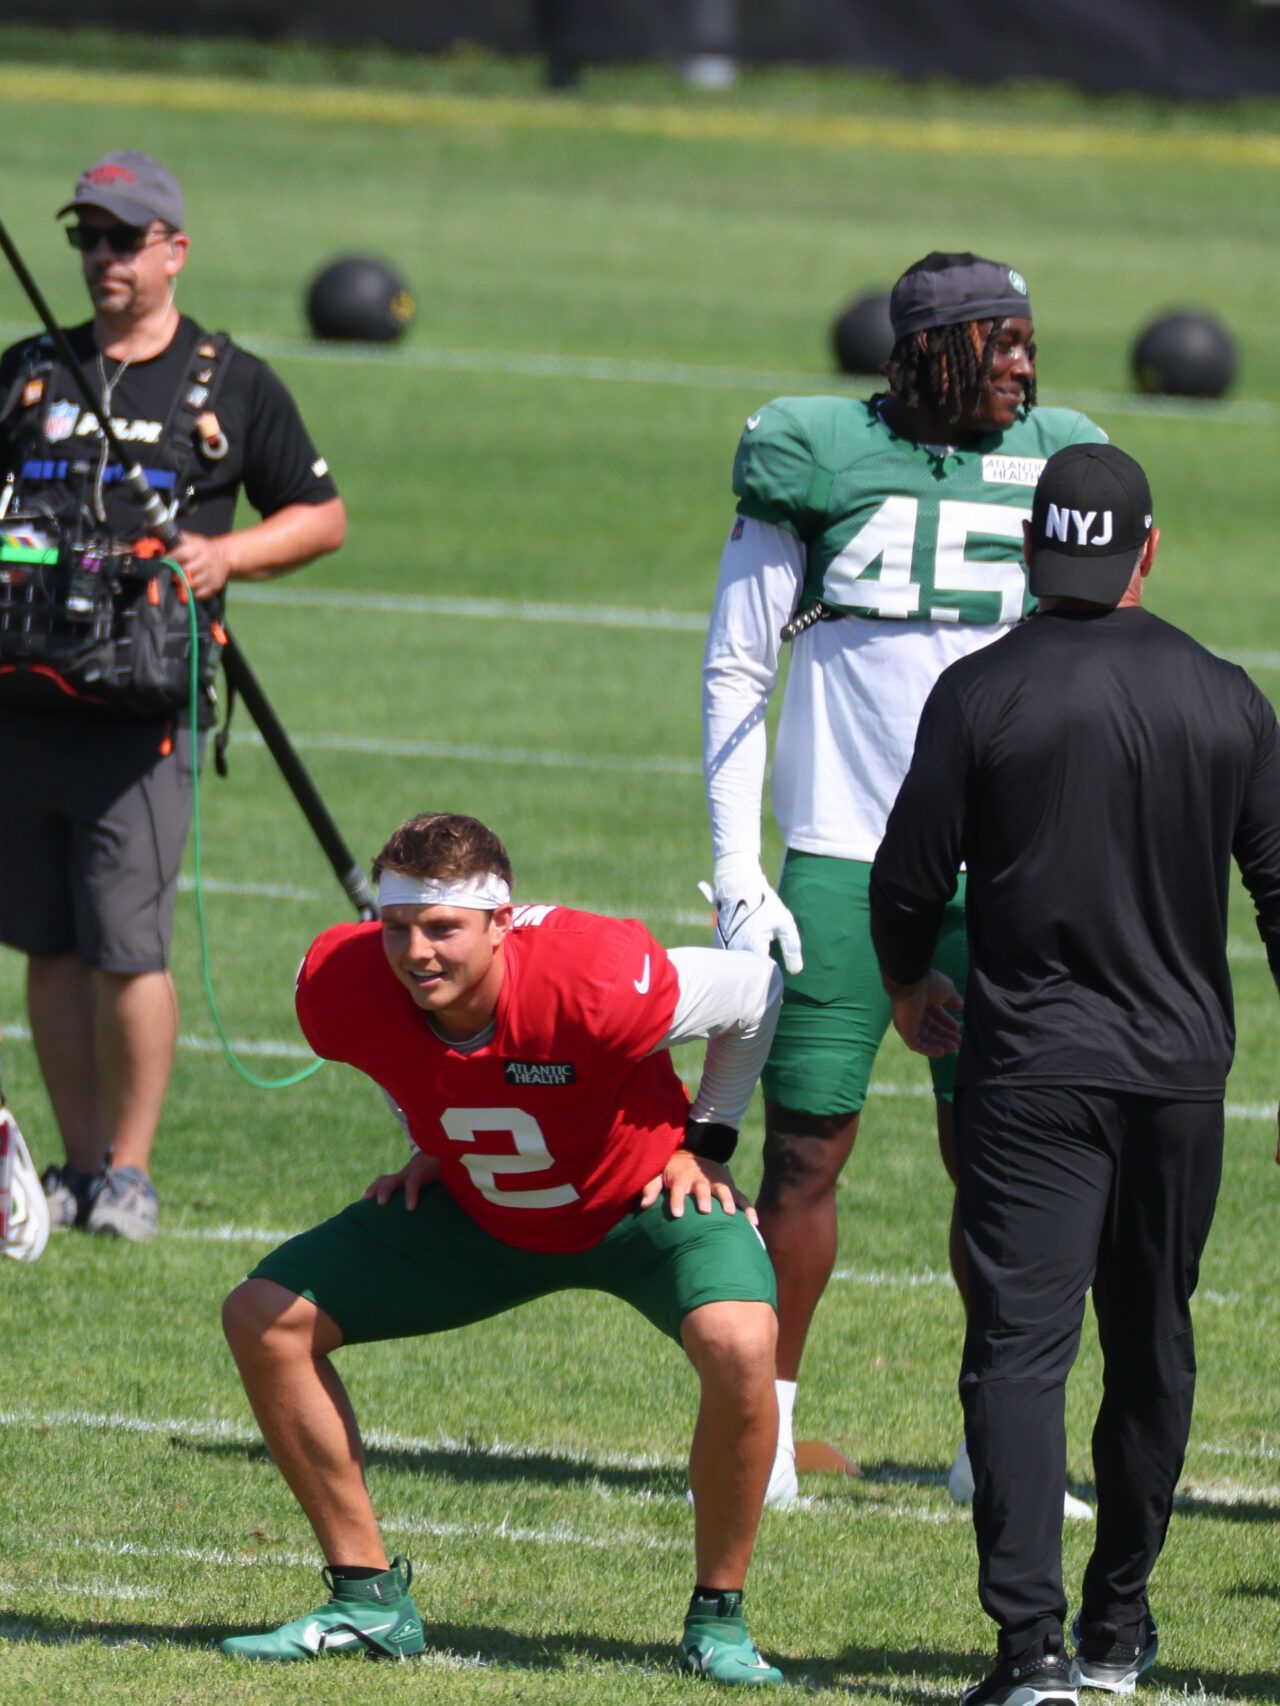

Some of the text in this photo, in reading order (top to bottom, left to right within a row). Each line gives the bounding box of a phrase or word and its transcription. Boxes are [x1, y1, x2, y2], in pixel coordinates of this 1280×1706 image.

[985, 459, 1042, 473] ATLANTI
[1045, 503, 1113, 546] NYJ
[822, 495, 1033, 620] 45
[506, 1062, 572, 1075] ATLANTIC
[515, 1073, 566, 1085] HEALTH
[440, 1107, 581, 1209] 2
